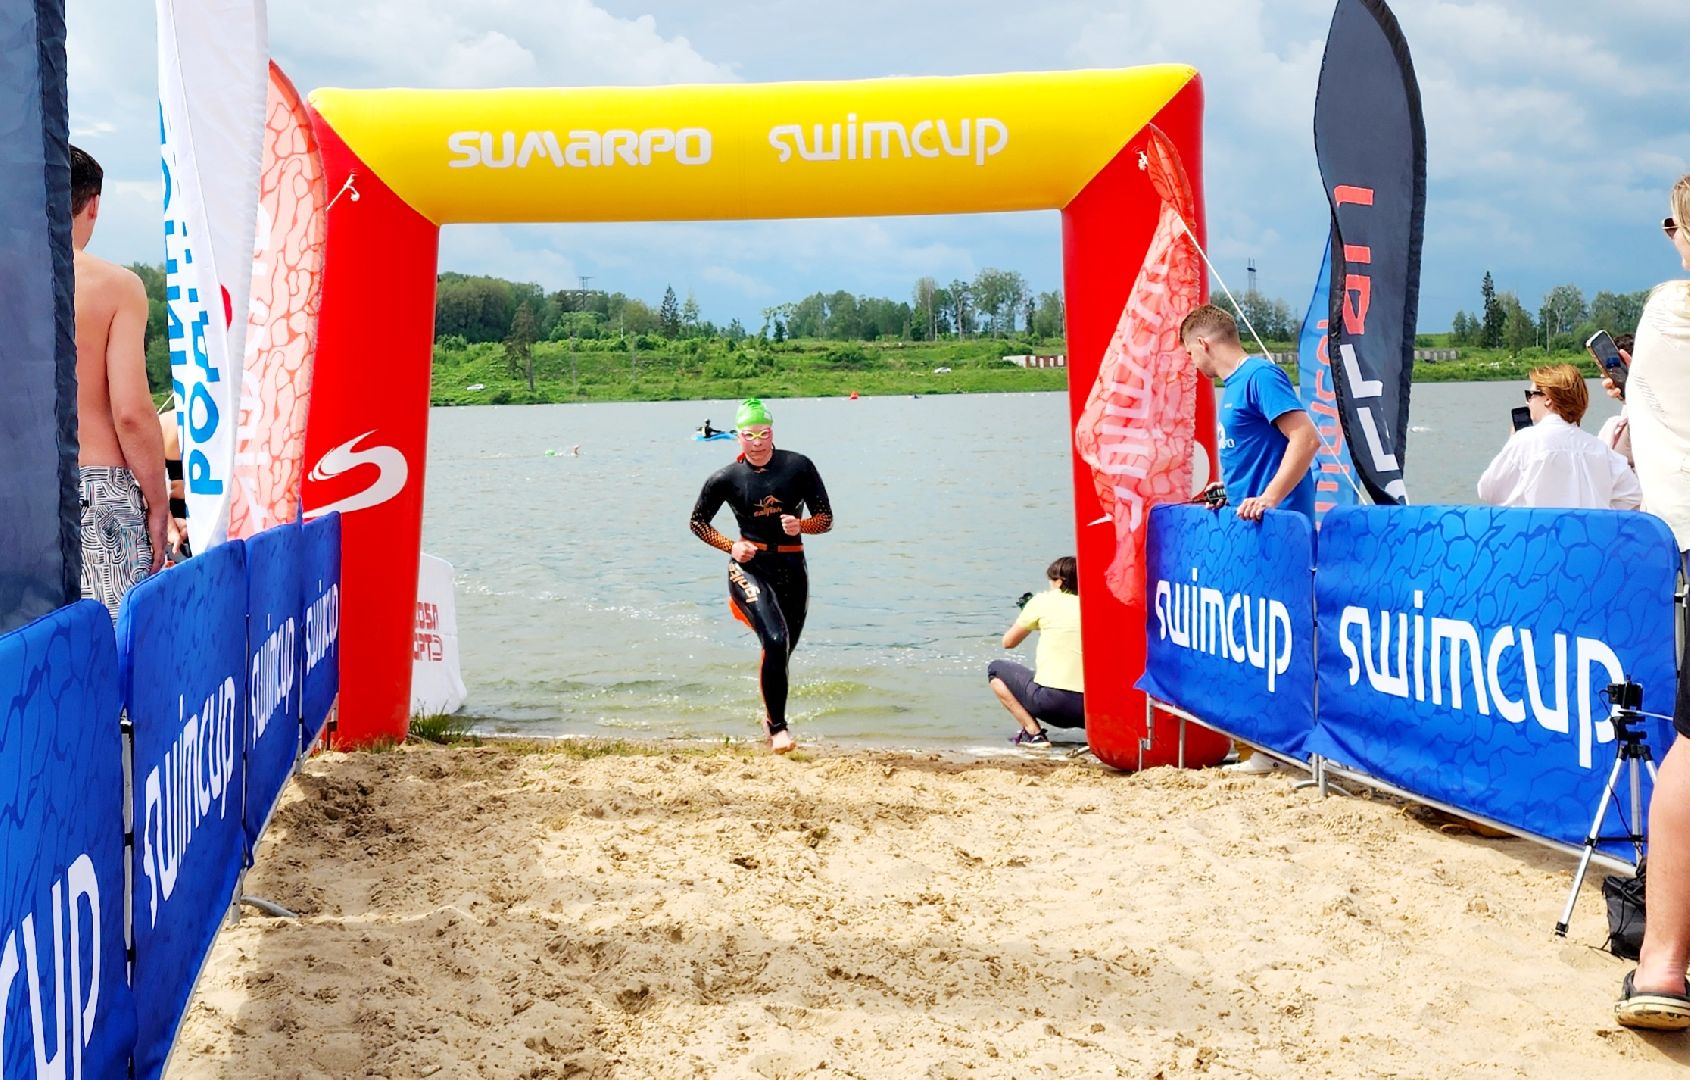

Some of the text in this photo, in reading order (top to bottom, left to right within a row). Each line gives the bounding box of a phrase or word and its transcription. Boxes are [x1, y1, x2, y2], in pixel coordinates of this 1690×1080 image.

[768, 113, 1008, 166] swimcup
[251, 613, 295, 750] swimcup
[1155, 567, 1292, 692] swimcup
[1338, 590, 1625, 769] swimcup
[143, 676, 236, 930] swimcup
